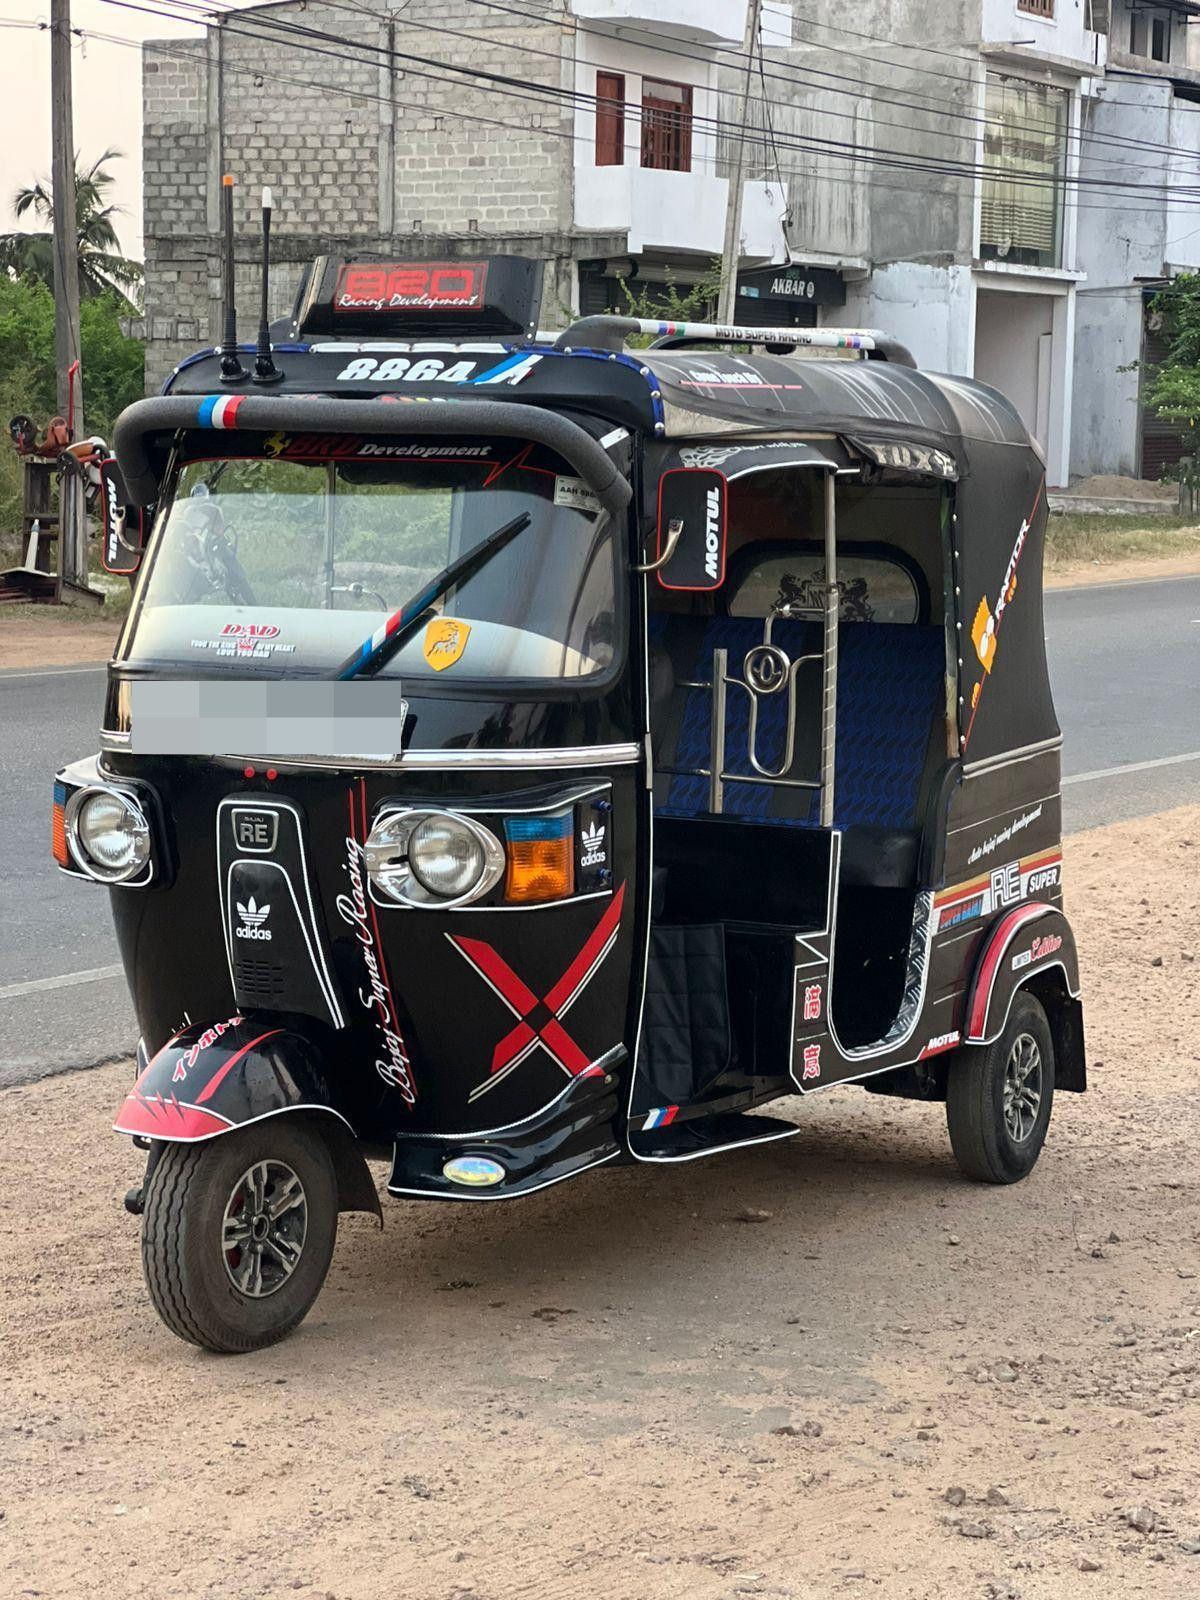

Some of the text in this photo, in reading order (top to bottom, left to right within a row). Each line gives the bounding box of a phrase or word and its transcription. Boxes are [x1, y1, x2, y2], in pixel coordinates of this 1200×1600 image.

[770, 278, 806, 296] AKBAR
[337, 293, 479, 310] Racing Development
[714, 327, 812, 344] MOTO SUPER RACING
[336, 357, 477, 383] 8864
[358, 444, 492, 458] Development
[560, 486, 578, 495] AAH
[106, 477, 118, 563] MOTUL
[705, 487, 720, 579] MOTUL
[219, 623, 281, 639] DAD
[216, 648, 271, 659] LOVE YOU DAD
[240, 822, 268, 843] RE
[581, 850, 606, 867] adidas
[336, 836, 374, 946] Racing
[990, 861, 1021, 914] RE
[1029, 869, 1058, 893] SUPER
[235, 926, 272, 940] adidas
[927, 1031, 960, 1051] MOTUL
